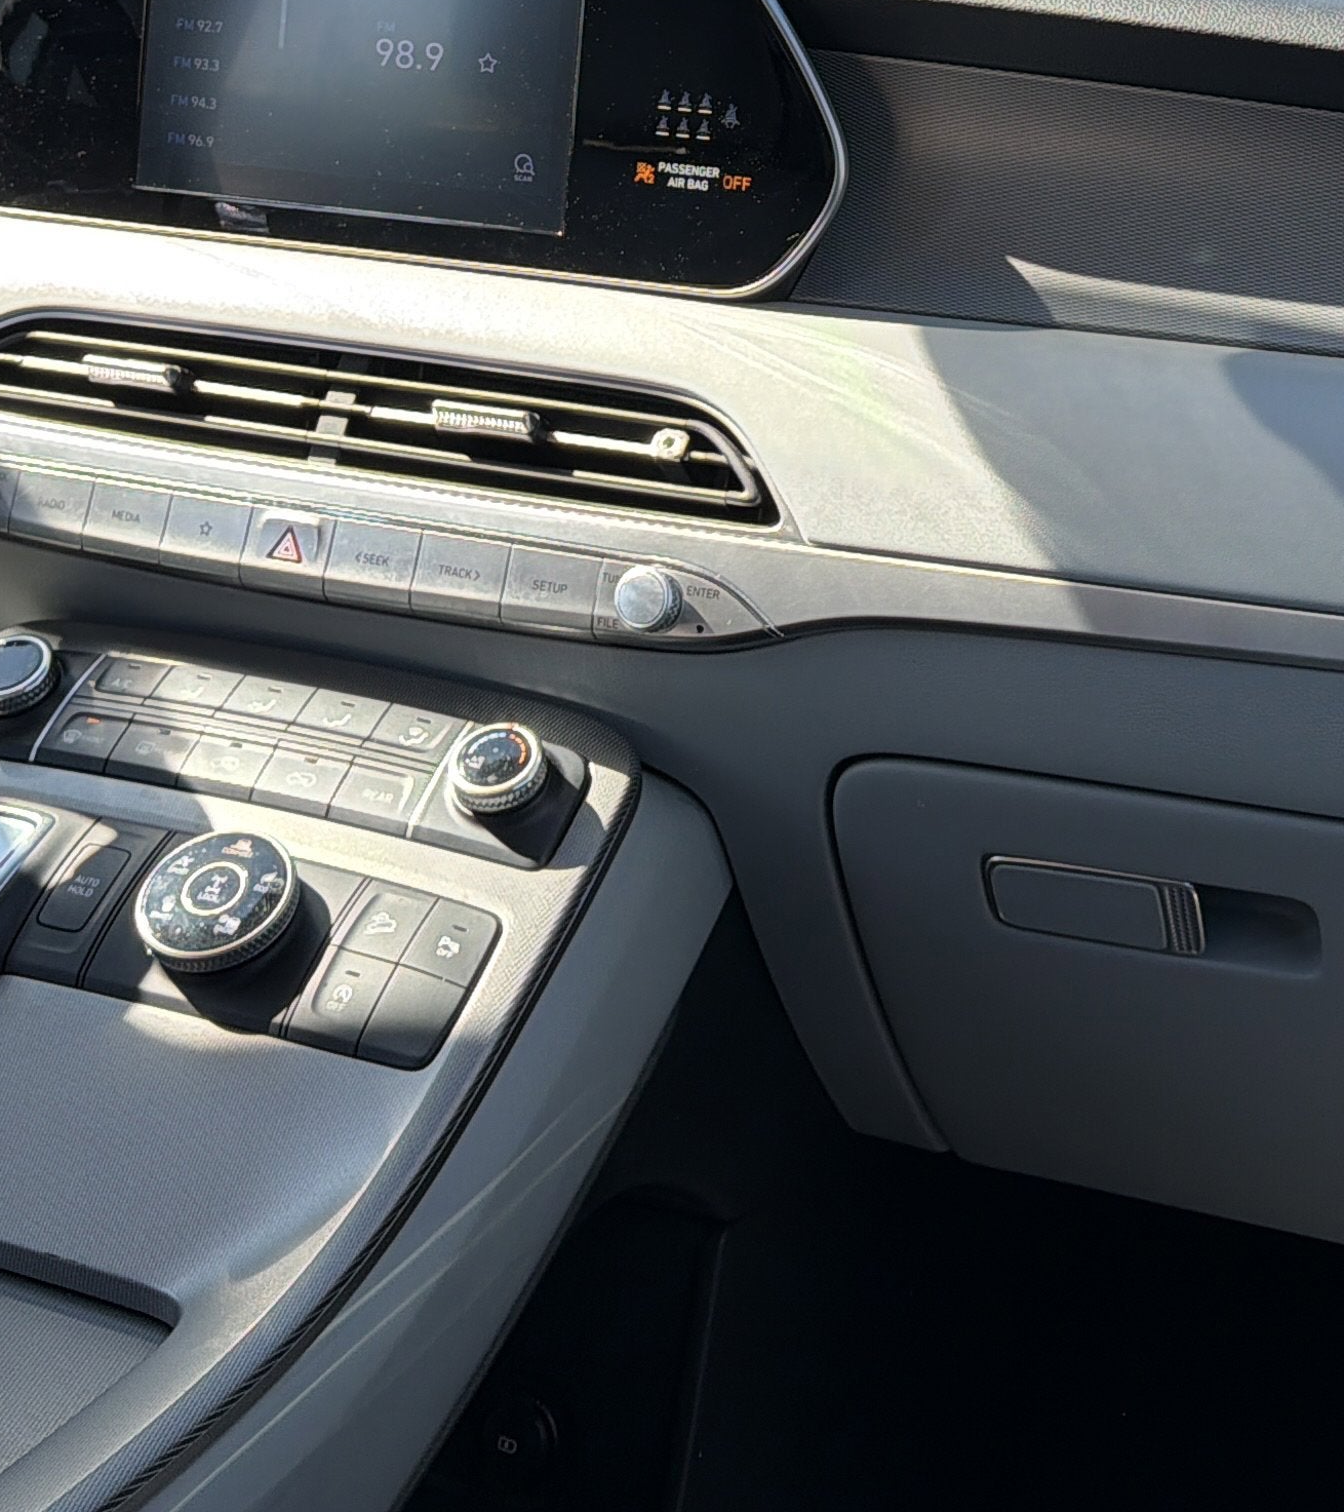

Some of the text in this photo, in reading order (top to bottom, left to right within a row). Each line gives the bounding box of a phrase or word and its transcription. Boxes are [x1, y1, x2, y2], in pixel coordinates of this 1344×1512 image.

[175, 18, 223, 34] FM 92.7
[377, 21, 396, 33] FM
[375, 38, 444, 72] 98.9
[173, 56, 221, 72] FM 93.3
[170, 94, 218, 110] FM 94.3
[167, 132, 215, 148] FM 96.9
[657, 161, 721, 179] PASSENGER
[667, 176, 709, 192] AIR BAG
[722, 175, 753, 192] OFF
[37, 497, 66, 511] RADIO
[111, 509, 142, 524] MEDIA
[362, 553, 391, 568] SEEK
[437, 564, 472, 580] TRACK
[531, 578, 569, 595] SETUP
[686, 585, 722, 601] ENTER
[597, 616, 620, 630] FILE
[362, 787, 395, 806] REAR
[74, 874, 101, 888] AUTO
[67, 884, 94, 898] HOLD
